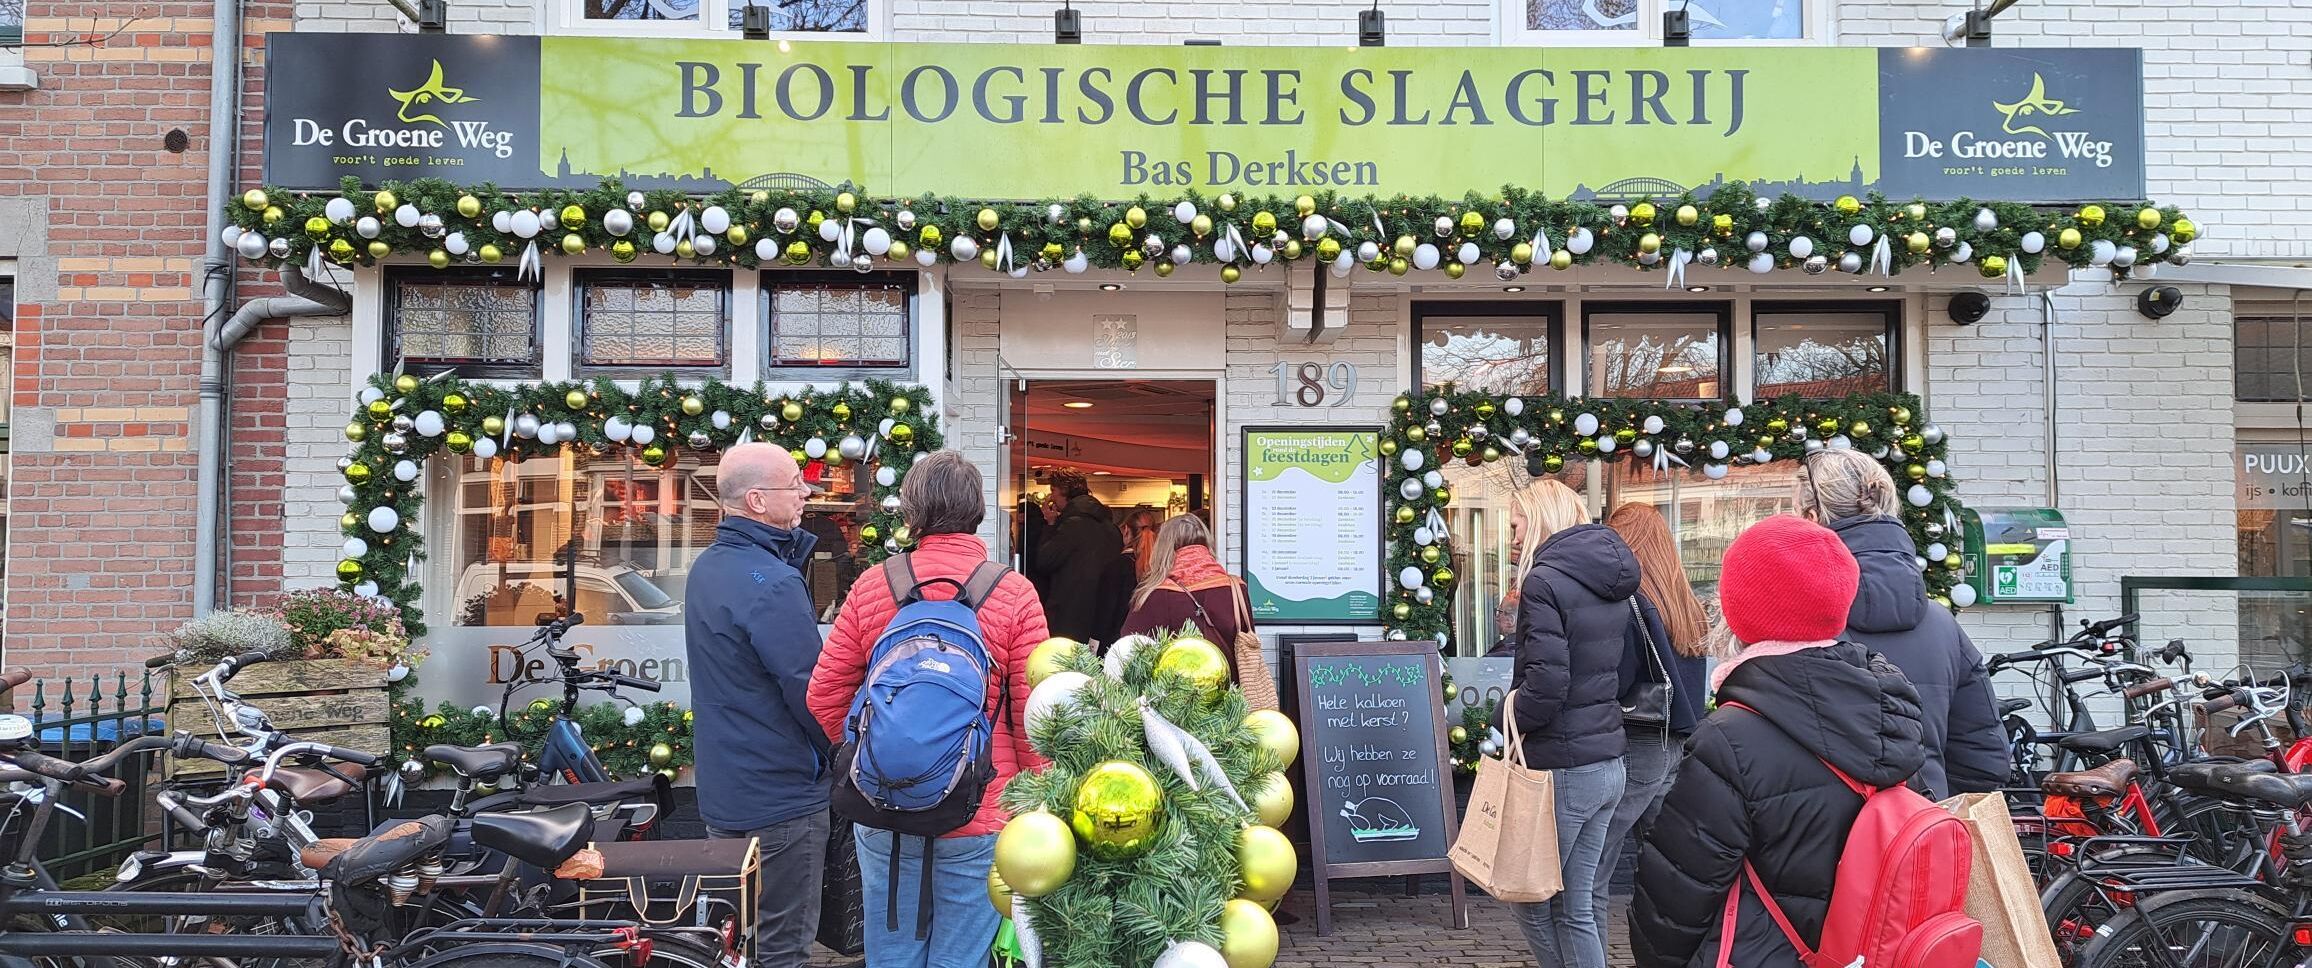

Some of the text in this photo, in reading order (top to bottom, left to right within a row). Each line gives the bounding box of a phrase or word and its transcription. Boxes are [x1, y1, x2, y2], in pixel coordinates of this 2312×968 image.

[674, 61, 1750, 137] BIOLOGISCHE SLAGERIJ
[292, 118, 513, 158] De Groene Weg
[1904, 131, 2113, 168] De Groene Weg
[333, 155, 464, 167] voor't goede leven
[1120, 149, 1379, 186] Bas Derksen
[1943, 166, 2067, 177] voor't goede leven
[1269, 360, 1358, 407] 189
[1256, 436, 1346, 449] Openingstijden
[1262, 448, 1350, 466] feestdagen
[2245, 454, 2311, 474] PUUX
[2246, 484, 2262, 500] ijs
[1999, 586, 2017, 594] AED
[1318, 694, 1405, 710] Hele kalkoen
[1327, 715, 1357, 728] met
[1324, 744, 1416, 772] Wij hebben ze
[1327, 776, 1351, 798] nog
[1355, 773, 1371, 797] op
